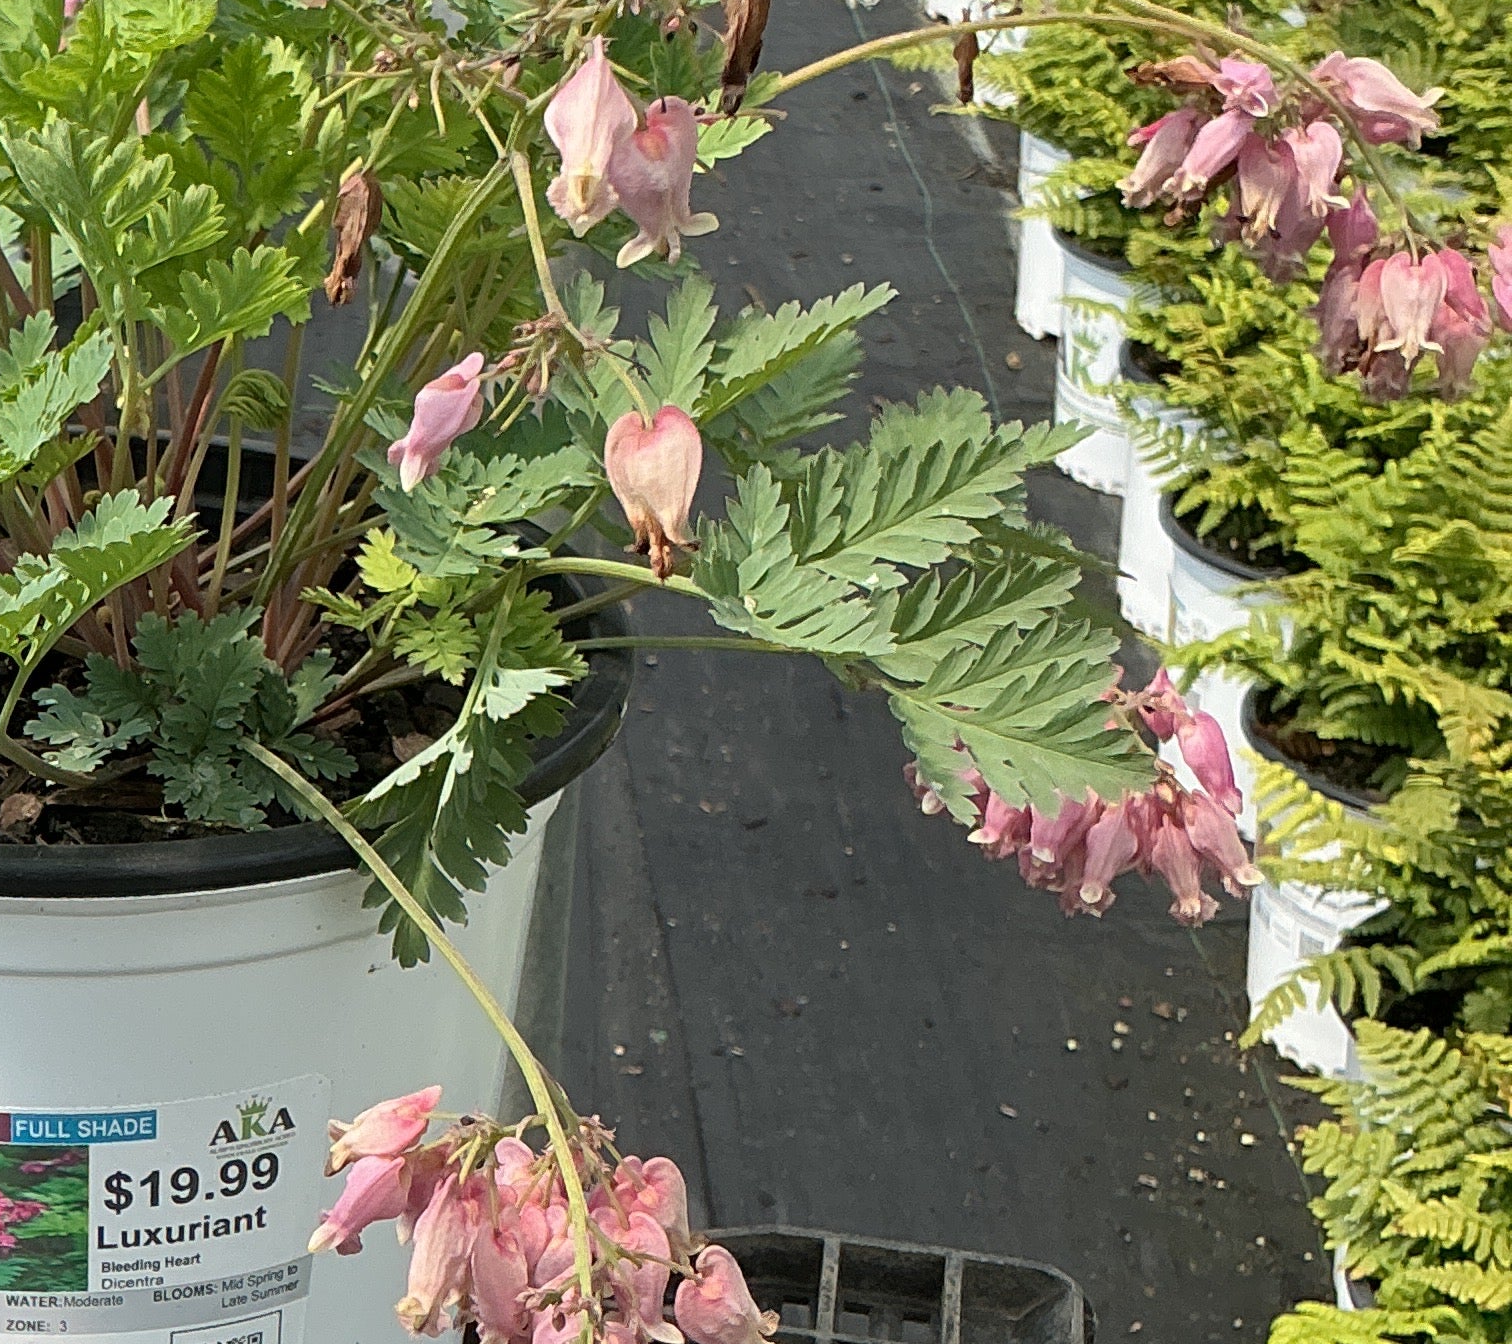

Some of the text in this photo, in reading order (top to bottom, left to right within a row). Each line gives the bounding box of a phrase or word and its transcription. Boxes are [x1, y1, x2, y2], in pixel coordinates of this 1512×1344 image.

[15, 1120, 71, 1138] FULL
[77, 1116, 154, 1138] SHADE
[208, 1107, 296, 1146] AKA
[104, 1152, 279, 1215] $19.99
[97, 1205, 267, 1249] Luxuriant
[101, 1253, 201, 1273] Bleeding Heart
[101, 1276, 164, 1290] Dicentra
[153, 1264, 299, 1303] BLOOMS: Mid Spring to
[222, 1279, 300, 1308] Late Summer
[6, 1293, 124, 1309] WATER: Moderate
[6, 1319, 68, 1333] ZONE: 3
